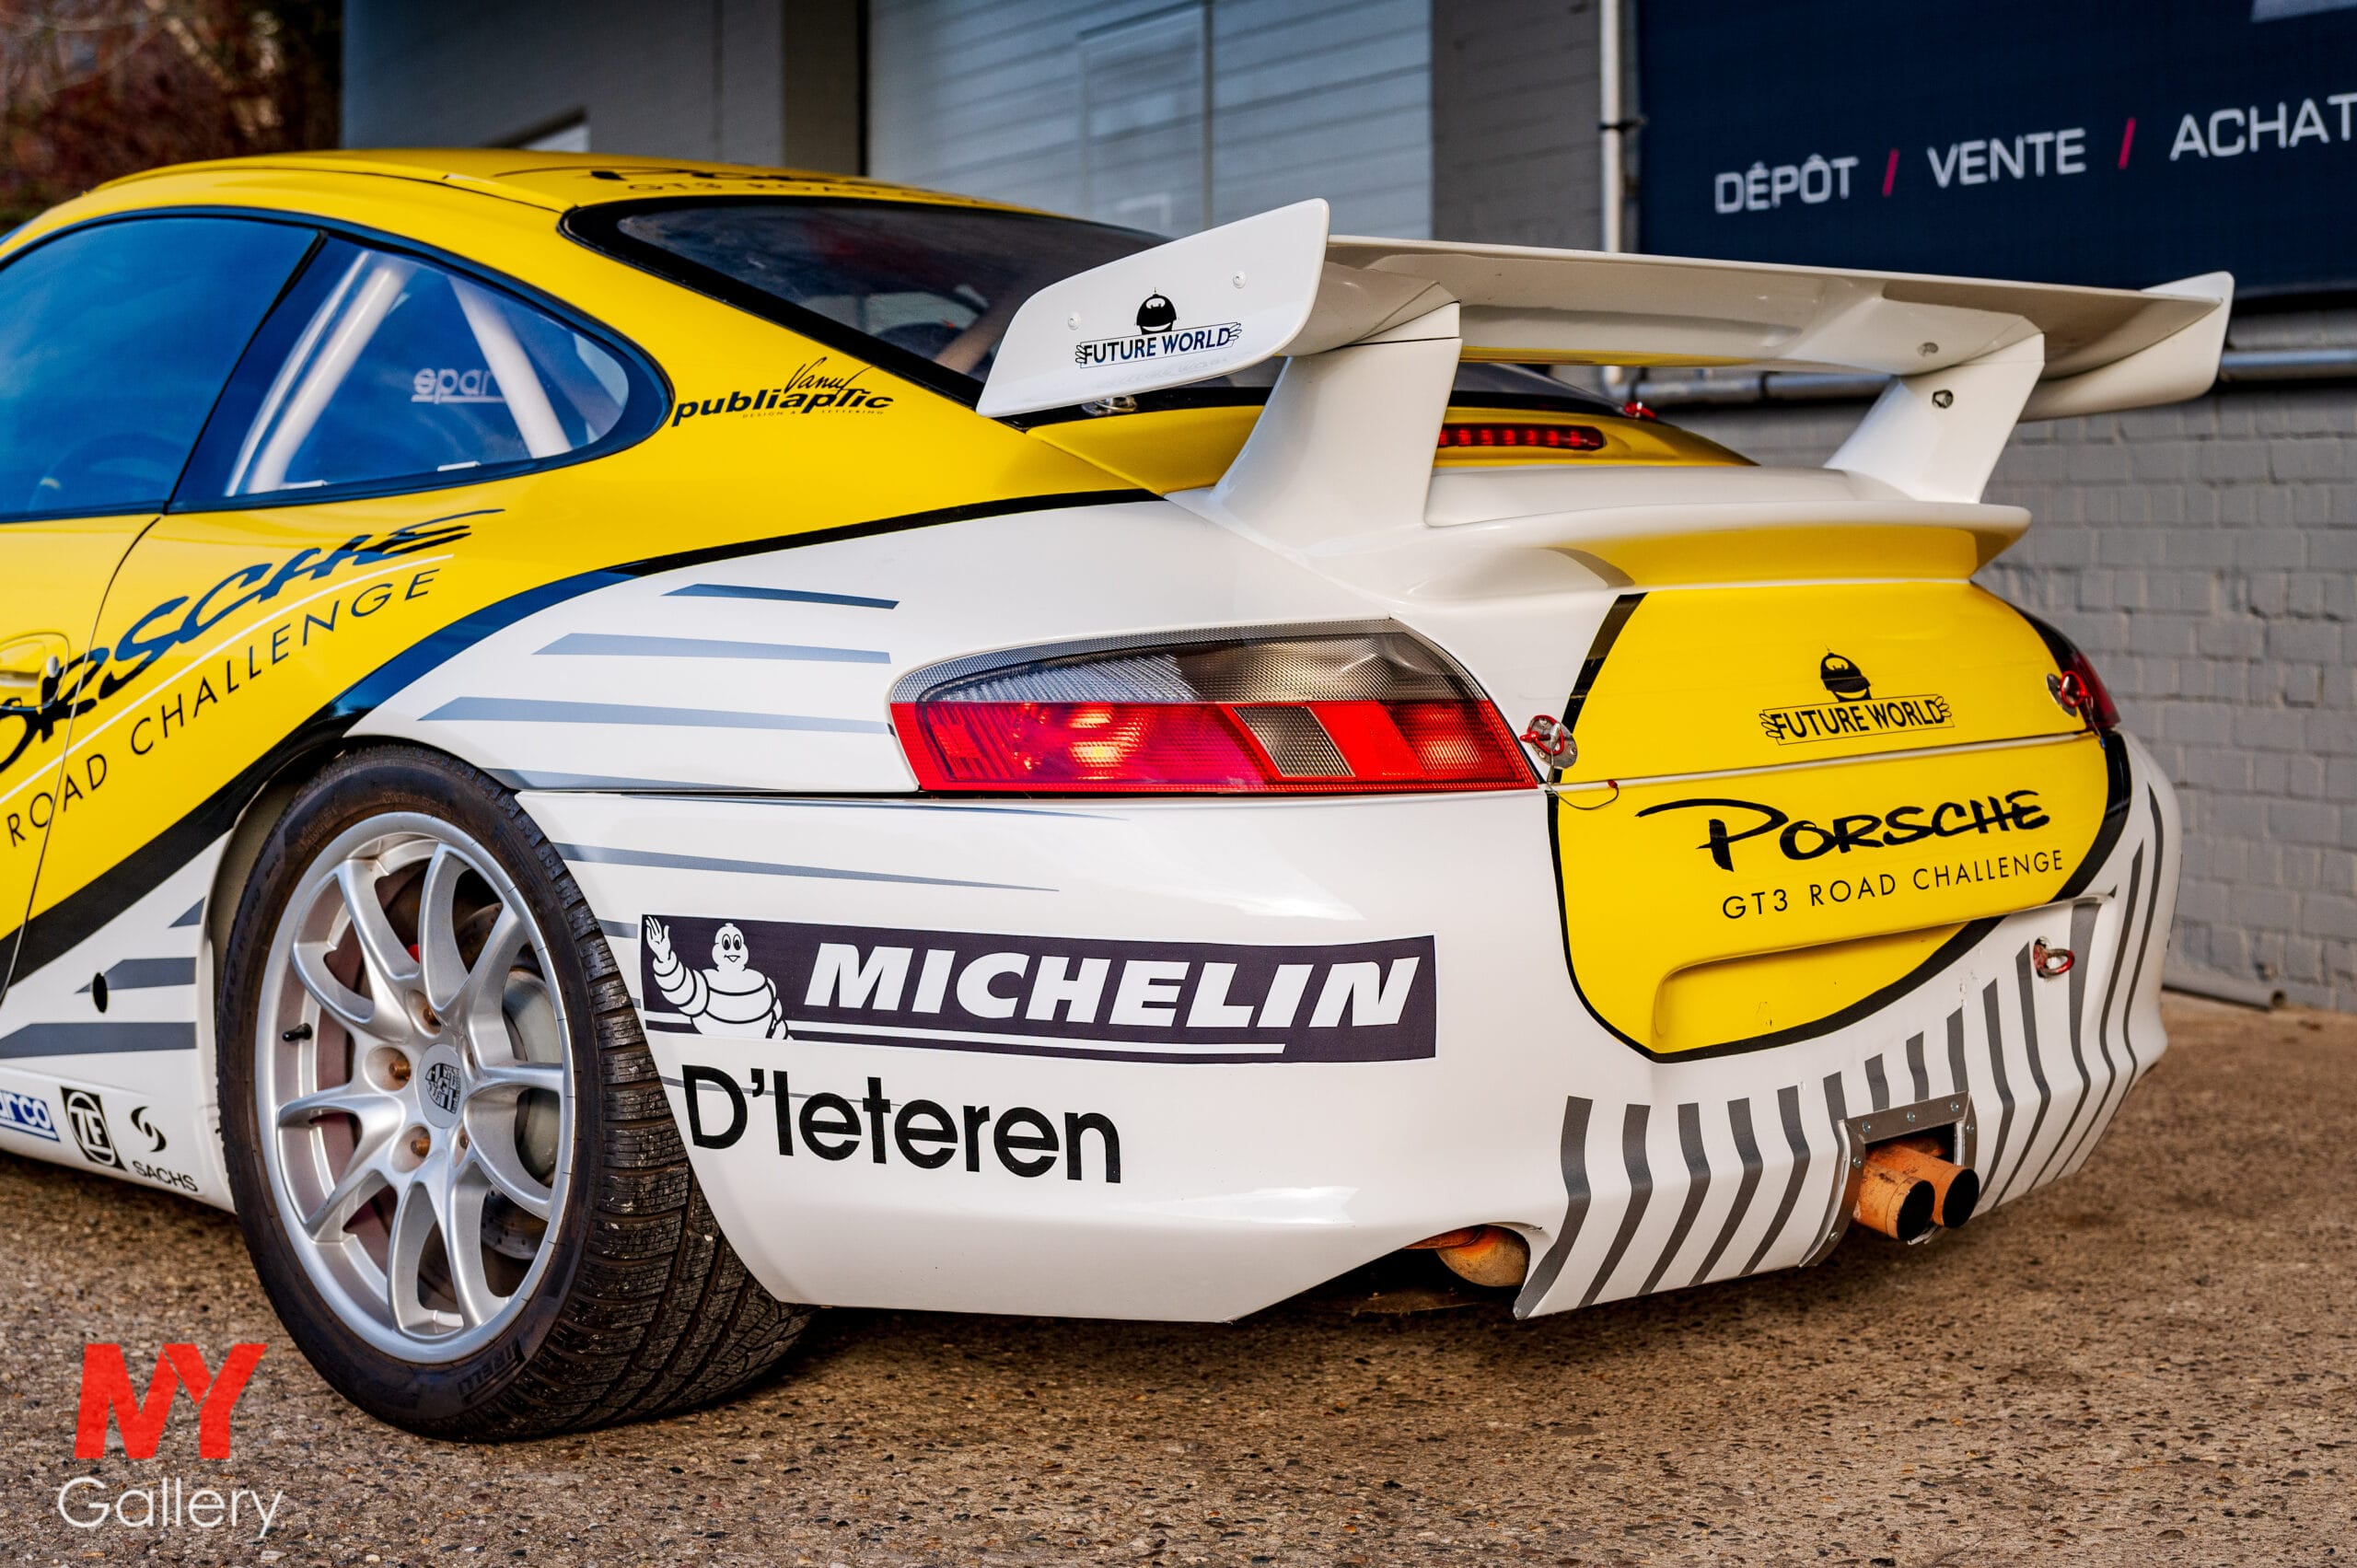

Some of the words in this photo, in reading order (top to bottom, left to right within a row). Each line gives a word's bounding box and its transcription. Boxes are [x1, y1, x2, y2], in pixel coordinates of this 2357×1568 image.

[1927, 127, 2086, 188] VENTE
[2169, 93, 2357, 162] ACHAT
[1084, 336, 1157, 365] FUTURE
[1161, 328, 1230, 354] WORLD
[6, 753, 108, 847] ROAD
[130, 568, 441, 756] CHALLENGE
[1771, 705, 1871, 740] FUTURE
[1864, 697, 1945, 729] WORLD
[1634, 789, 2051, 872] PORSCHE
[1722, 888, 1789, 920] GT3
[1810, 874, 1897, 907] ROAD
[1912, 850, 2064, 891] CHALLENGE
[803, 942, 1421, 1028] MICHELIN
[132, 1160, 199, 1193] SACHS
